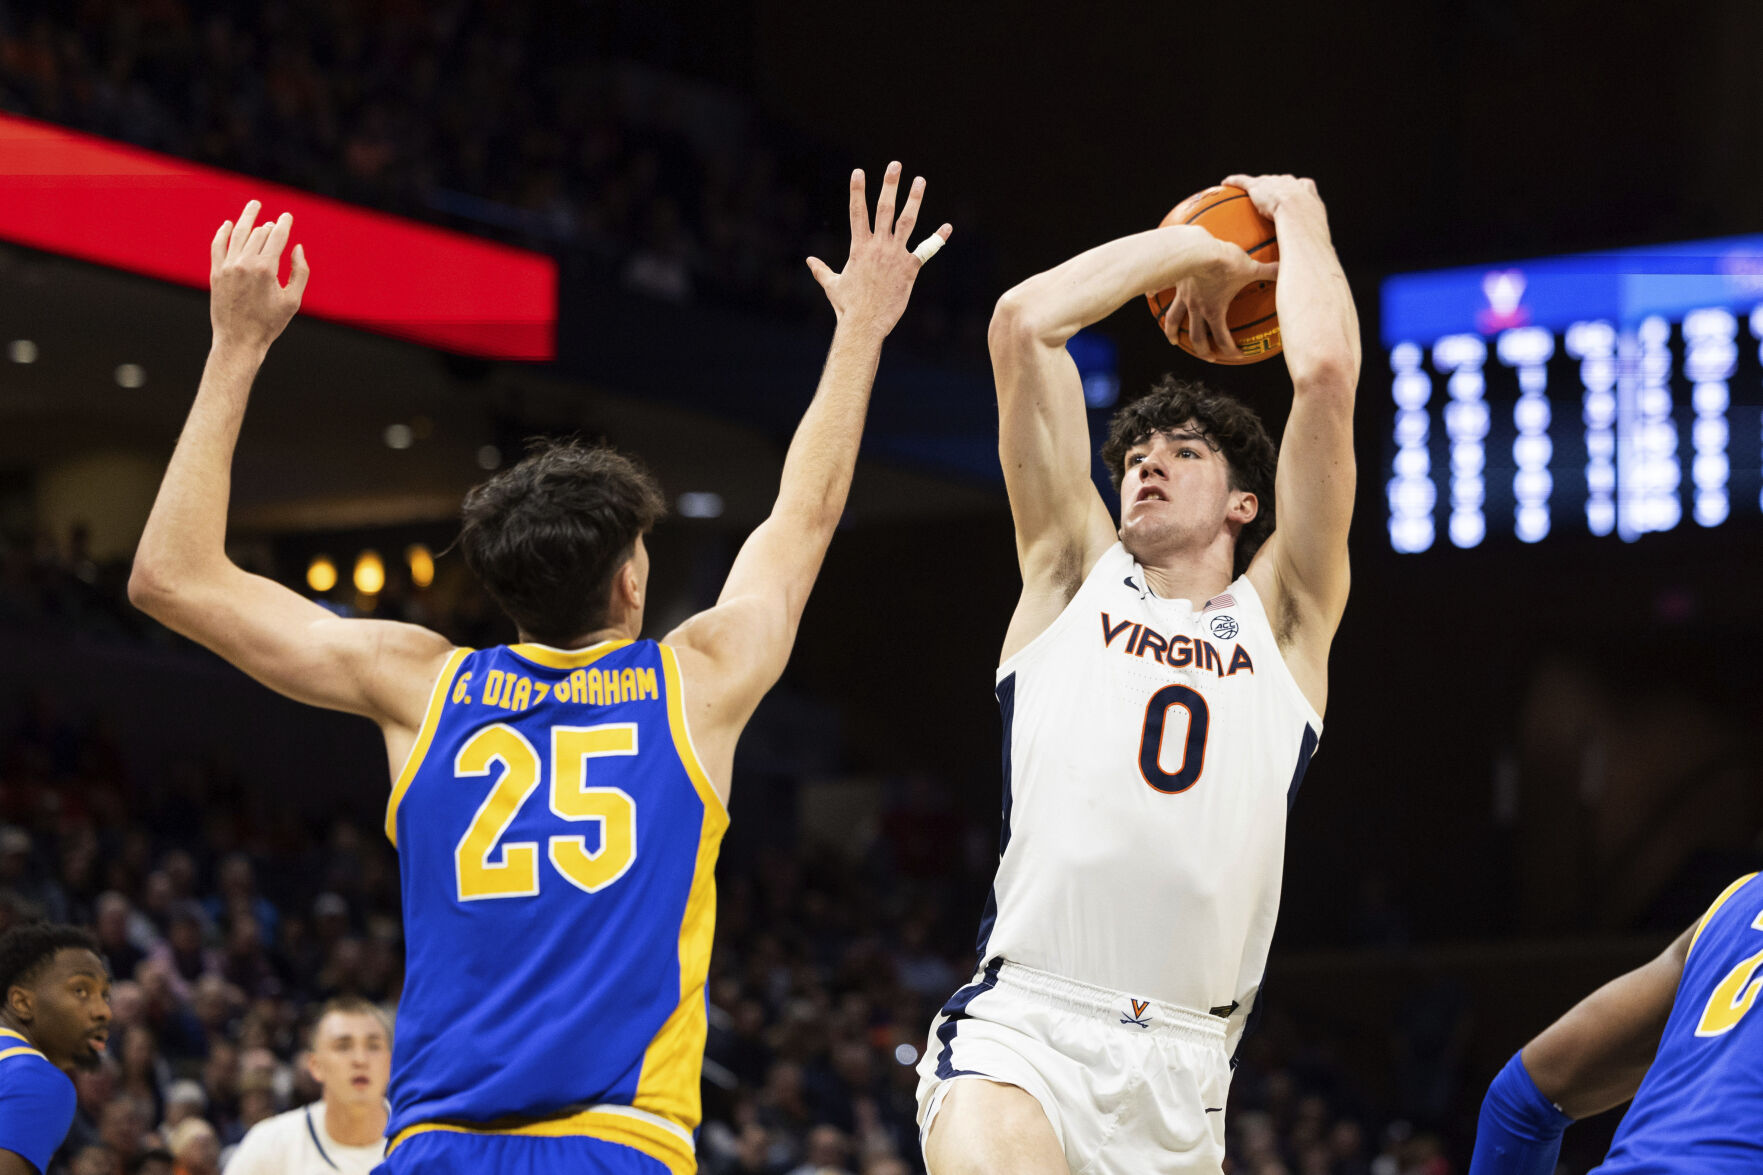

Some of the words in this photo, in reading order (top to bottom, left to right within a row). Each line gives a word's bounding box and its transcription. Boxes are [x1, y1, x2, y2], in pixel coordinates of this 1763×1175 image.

[482, 670, 551, 711] DIAZ
[553, 667, 659, 706] GRAHAM
[1101, 612, 1254, 678] VIRGINA
[1138, 683, 1210, 795] 0
[454, 723, 638, 902] 25
